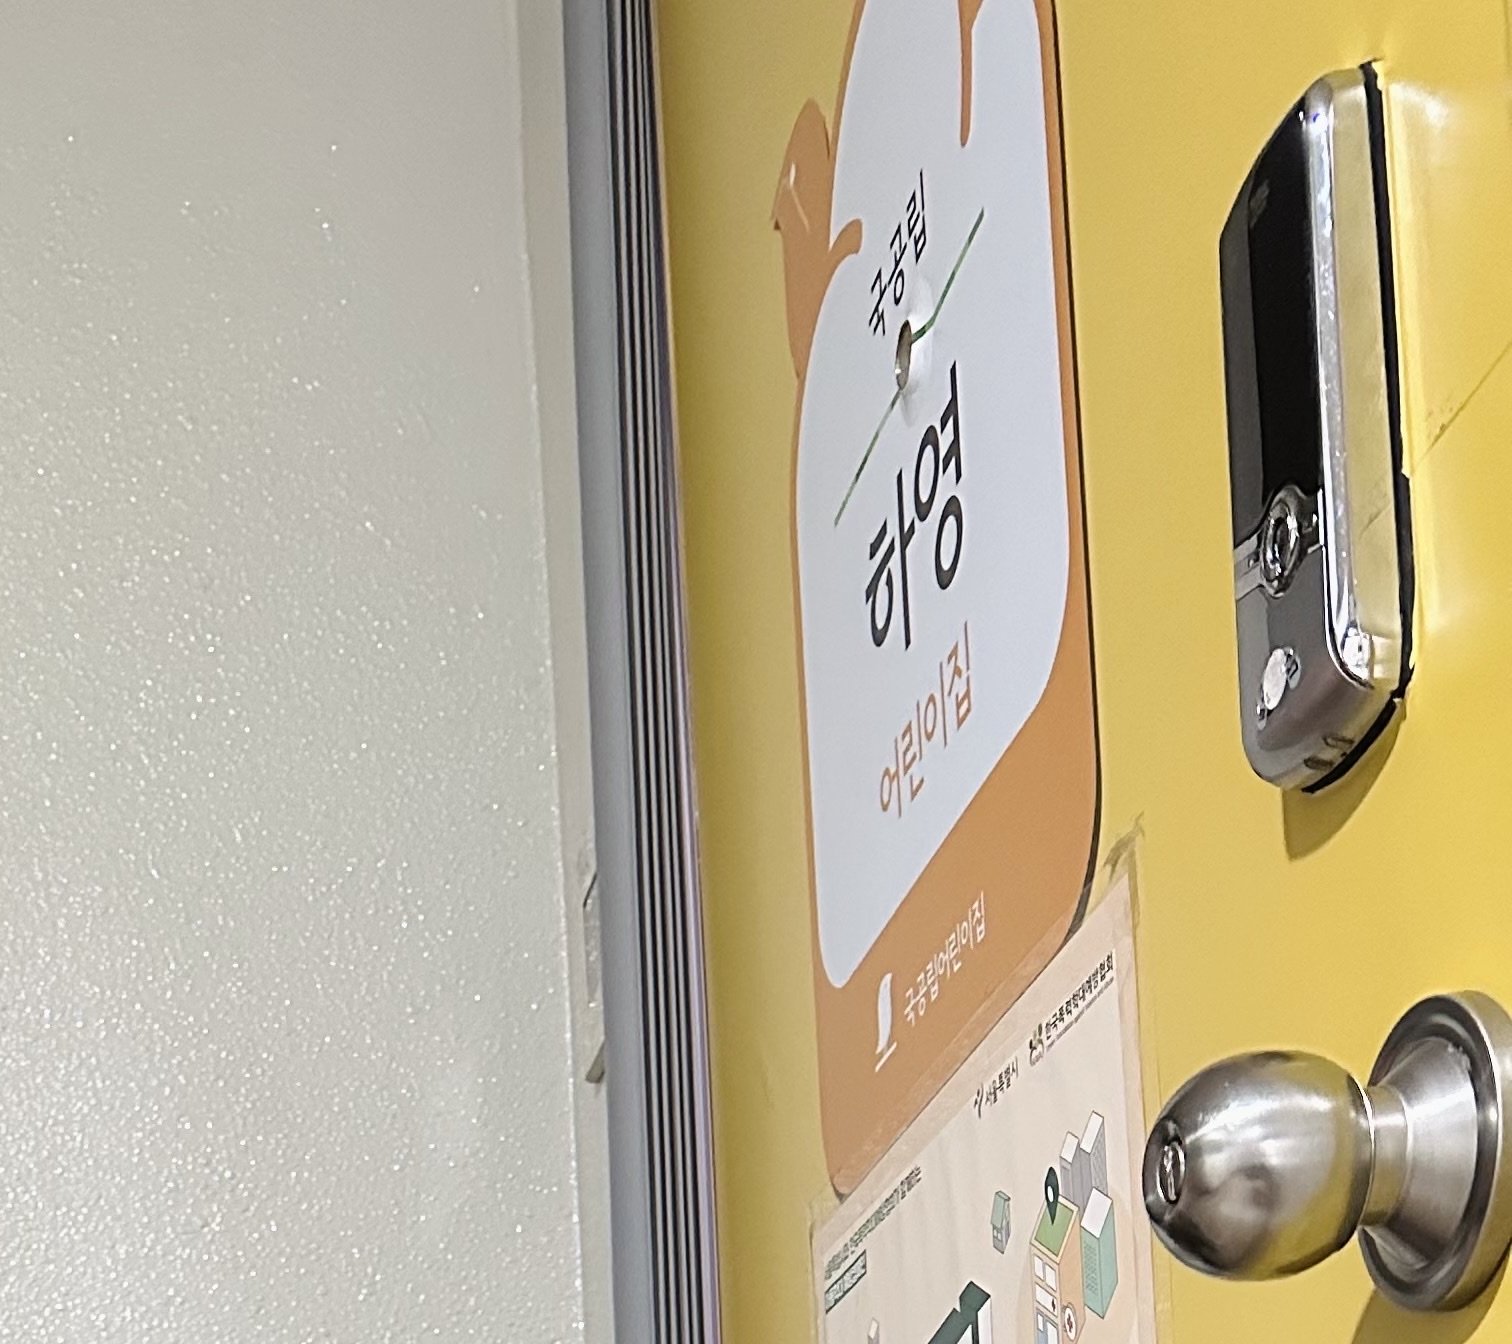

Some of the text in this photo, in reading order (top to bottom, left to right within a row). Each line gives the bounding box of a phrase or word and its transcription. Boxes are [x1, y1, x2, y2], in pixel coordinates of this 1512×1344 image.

[868, 168, 927, 337] 국공립
[865, 360, 963, 651] 하영
[879, 619, 973, 819] 어린이집
[903, 890, 987, 1027] 국공립어린이집
[985, 1056, 1019, 1107] 서울특별시
